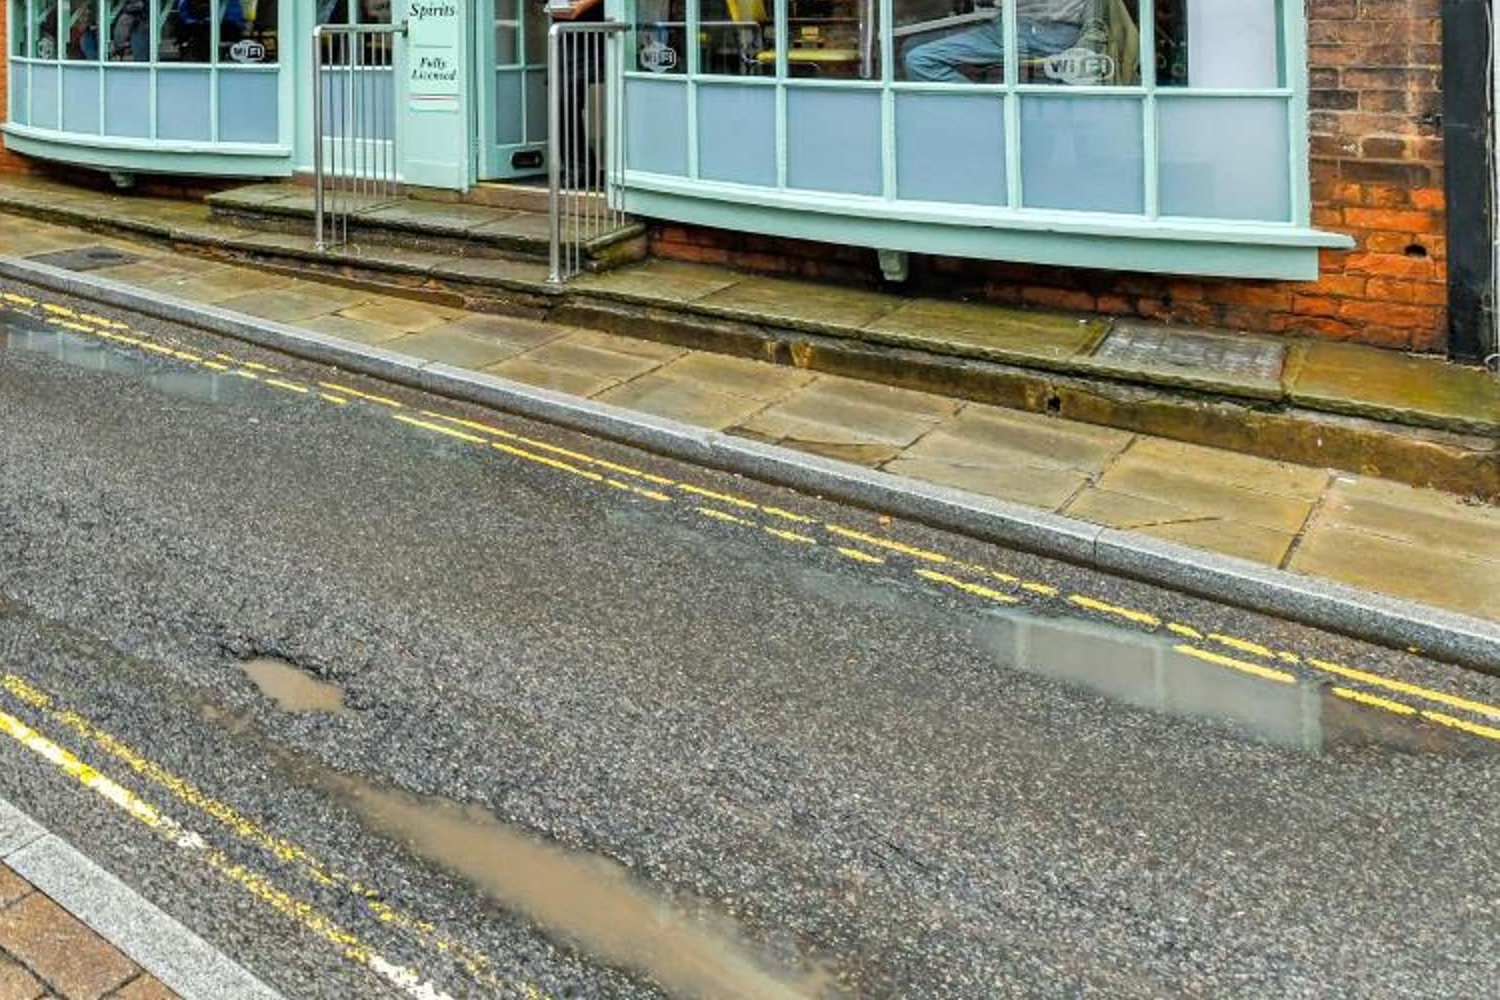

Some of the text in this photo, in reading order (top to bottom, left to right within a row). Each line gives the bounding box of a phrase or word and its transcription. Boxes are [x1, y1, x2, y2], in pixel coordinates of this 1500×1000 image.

[410, 3, 455, 20] Spirits
[420, 57, 446, 70] Fully
[412, 69, 456, 81] Licensed
